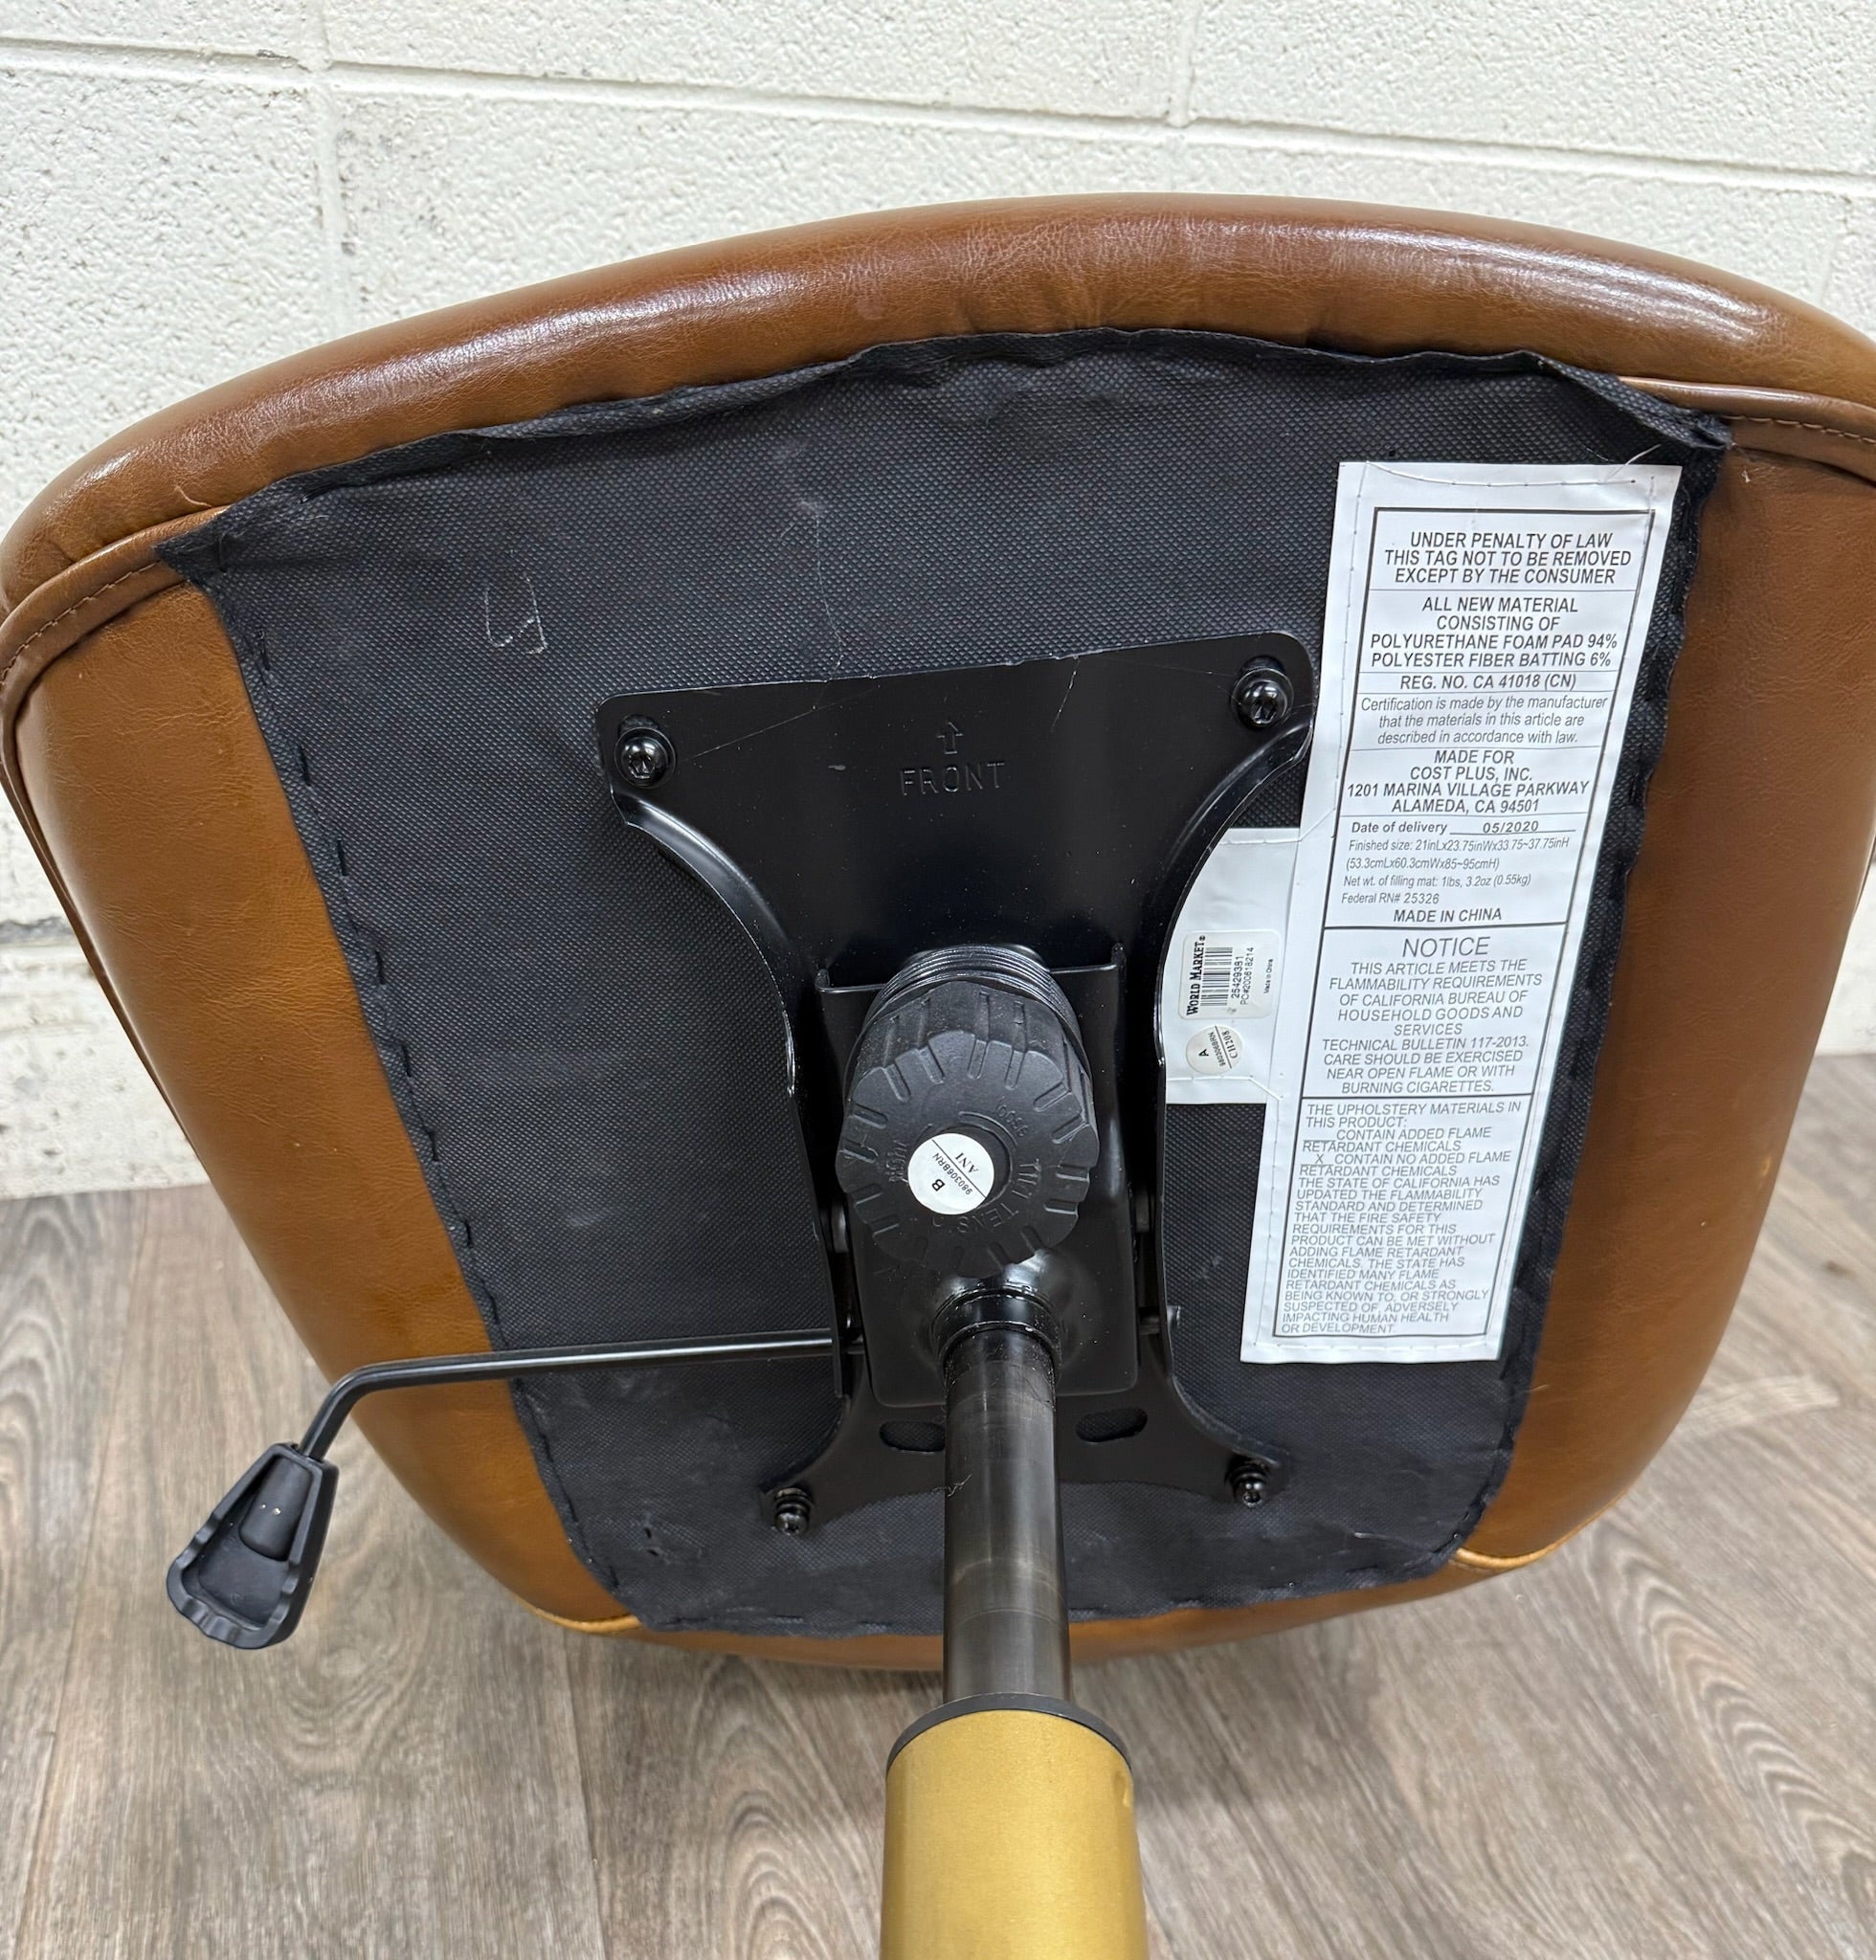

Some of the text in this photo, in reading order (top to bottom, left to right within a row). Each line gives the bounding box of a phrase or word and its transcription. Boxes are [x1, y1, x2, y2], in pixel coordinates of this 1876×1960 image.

[1410, 531, 1613, 548] UNDER PENALTY OF LAW
[1383, 549, 1632, 567] THIS TAG NOT TO BE REMOVED
[1395, 568, 1616, 584] EXCEPT BY THE CONSUMER
[1421, 596, 1580, 612] ALL NEW MATERIAL
[1436, 615, 1560, 632] CONSISTING OF
[1371, 634, 1619, 649] POLYURETHANE FOAM PAD 94%
[1371, 652, 1612, 667] POLYESTER FIBER BATTING 6%
[1400, 673, 1576, 691] REG. NO. CA 41018 (CN)
[1360, 695, 1608, 713] Certification is made by the manufacturer
[1378, 713, 1584, 727] that the materials in this article are
[1376, 729, 1578, 745] described in accordance with law.
[1434, 749, 1515, 764] MADE FOR
[900, 762, 1005, 796] FRONT
[1409, 766, 1533, 782] COST PLUS, INC.
[1347, 781, 1589, 796] 1201 MARINA VILLAGE PARKWAY
[1391, 798, 1539, 814] ALAMEDA, CA 94501
[1351, 820, 1539, 836] Date of delivery 05/2020
[1348, 838, 1389, 851] Finished
[1390, 838, 1414, 851] size:
[1343, 875, 1360, 887] Net
[1361, 875, 1376, 887] wt.
[1377, 875, 1388, 887] of
[1389, 875, 1415, 890] filling
[1464, 875, 1492, 887] 3.2oz
[1492, 873, 1531, 888] (0.55kg)
[1341, 892, 1440, 904] Federal RN# 25326
[1393, 907, 1503, 923] MADE IN CHINA
[1402, 936, 1490, 958] NOTICE
[1350, 959, 1527, 974] THIS ARTICLE MEETS THE
[1329, 974, 1543, 990] FLAMMABILITY REQUIREMENTS
[1186, 984, 1201, 1016] WORLD
[1339, 991, 1528, 1006] OF CALIFORNIA BUREAU OF
[1337, 1005, 1523, 1021] HOUSEHOLD GOODS AND
[1393, 1023, 1463, 1036] SERVICES
[1321, 1036, 1530, 1050] TECHNICAL BULLETIN 117-2013.
[1198, 1048, 1210, 1058] A
[1323, 1051, 1523, 1065] CARE SHOULD BE EXERCISED
[1327, 1065, 1515, 1080] NEAR OPEN FLAME OR WITH
[1341, 1080, 1495, 1094] BURNING CIGARETTES.
[1306, 1102, 1521, 1115] THE UPHOLSTERY MATERIALS IN
[1305, 1117, 1407, 1127] THIS PRODUCT:
[1335, 1126, 1491, 1140] CONTAIN ADDED FLAME
[1302, 1141, 1462, 1151] RETARDANT CHEMICALS
[954, 1151, 980, 1174] ANI
[1314, 1150, 1511, 1165] X CONTAIN NO ADDED FLAME
[932, 1151, 973, 1195] 980306BRN
[1299, 1166, 1457, 1175] RETARDANT CHEMICALS
[931, 1177, 946, 1192] B
[1297, 1175, 1500, 1189] THE STATE OF CALIFORNIA HAS
